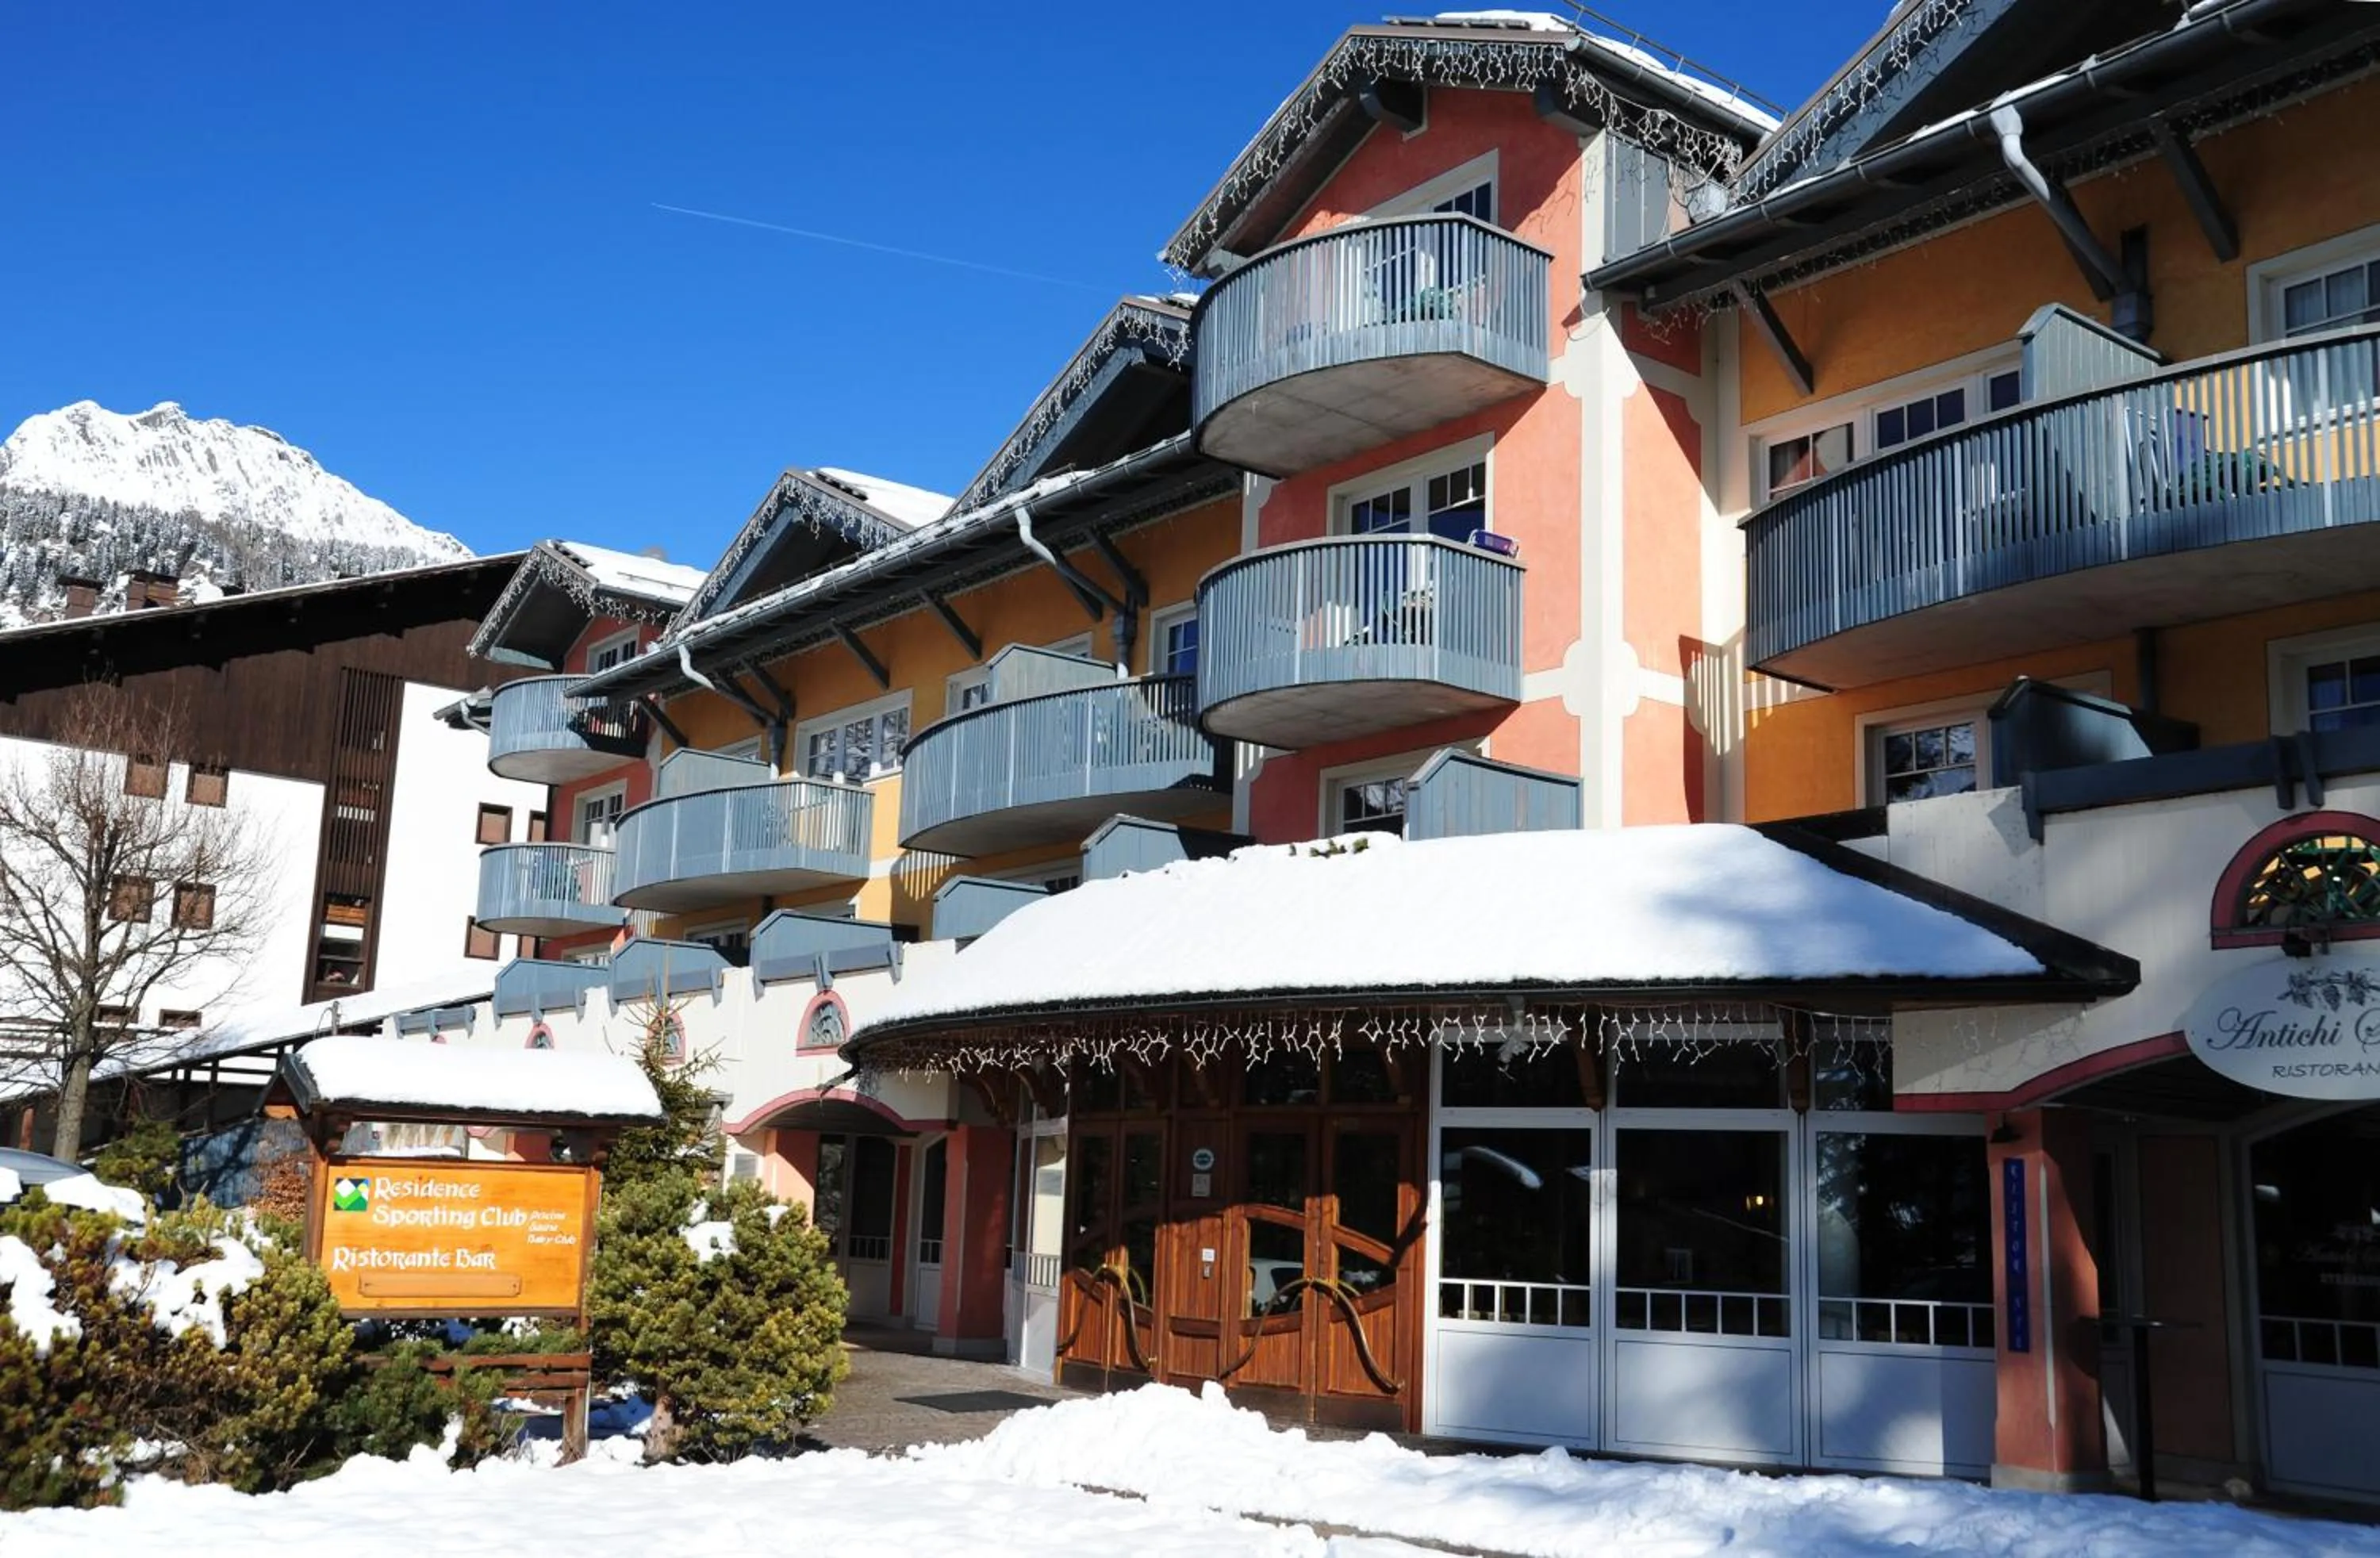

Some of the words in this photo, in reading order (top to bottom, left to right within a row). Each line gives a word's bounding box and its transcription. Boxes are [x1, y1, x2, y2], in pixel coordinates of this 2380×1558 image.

[2206, 1007, 2343, 1050] Antichi
[374, 1176, 481, 1201] Residence
[372, 1204, 475, 1230] Sporting
[481, 1207, 528, 1226] Club
[332, 1246, 451, 1272] Ristorante
